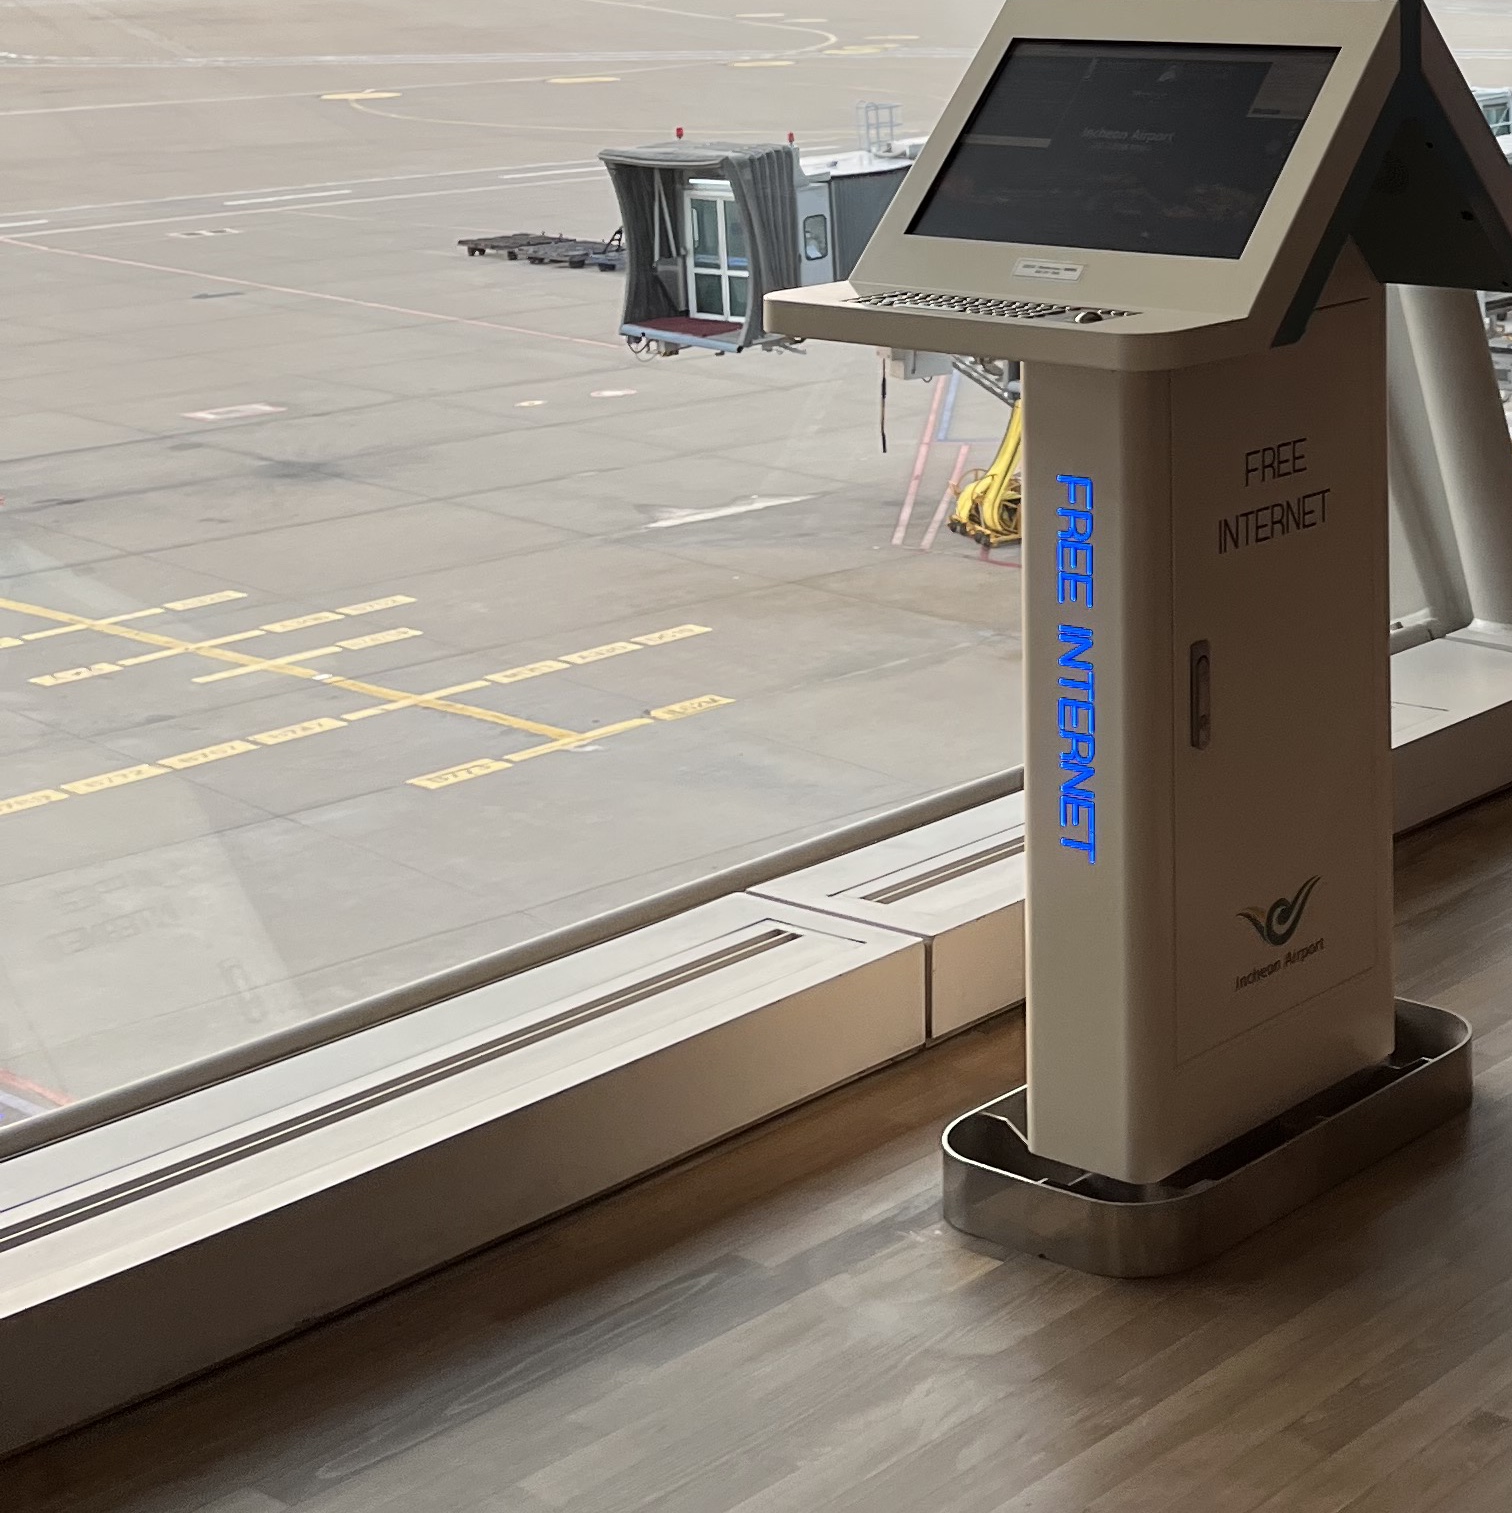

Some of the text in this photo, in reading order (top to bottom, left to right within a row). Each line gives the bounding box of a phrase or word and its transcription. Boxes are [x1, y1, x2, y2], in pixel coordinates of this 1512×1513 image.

[1132, 128, 1175, 143] Airport
[1245, 437, 1308, 487] FREE
[1218, 488, 1331, 555] INTERNET
[1056, 473, 1096, 866] FREE INTERNET
[1235, 938, 1325, 992] Incheon Airport
